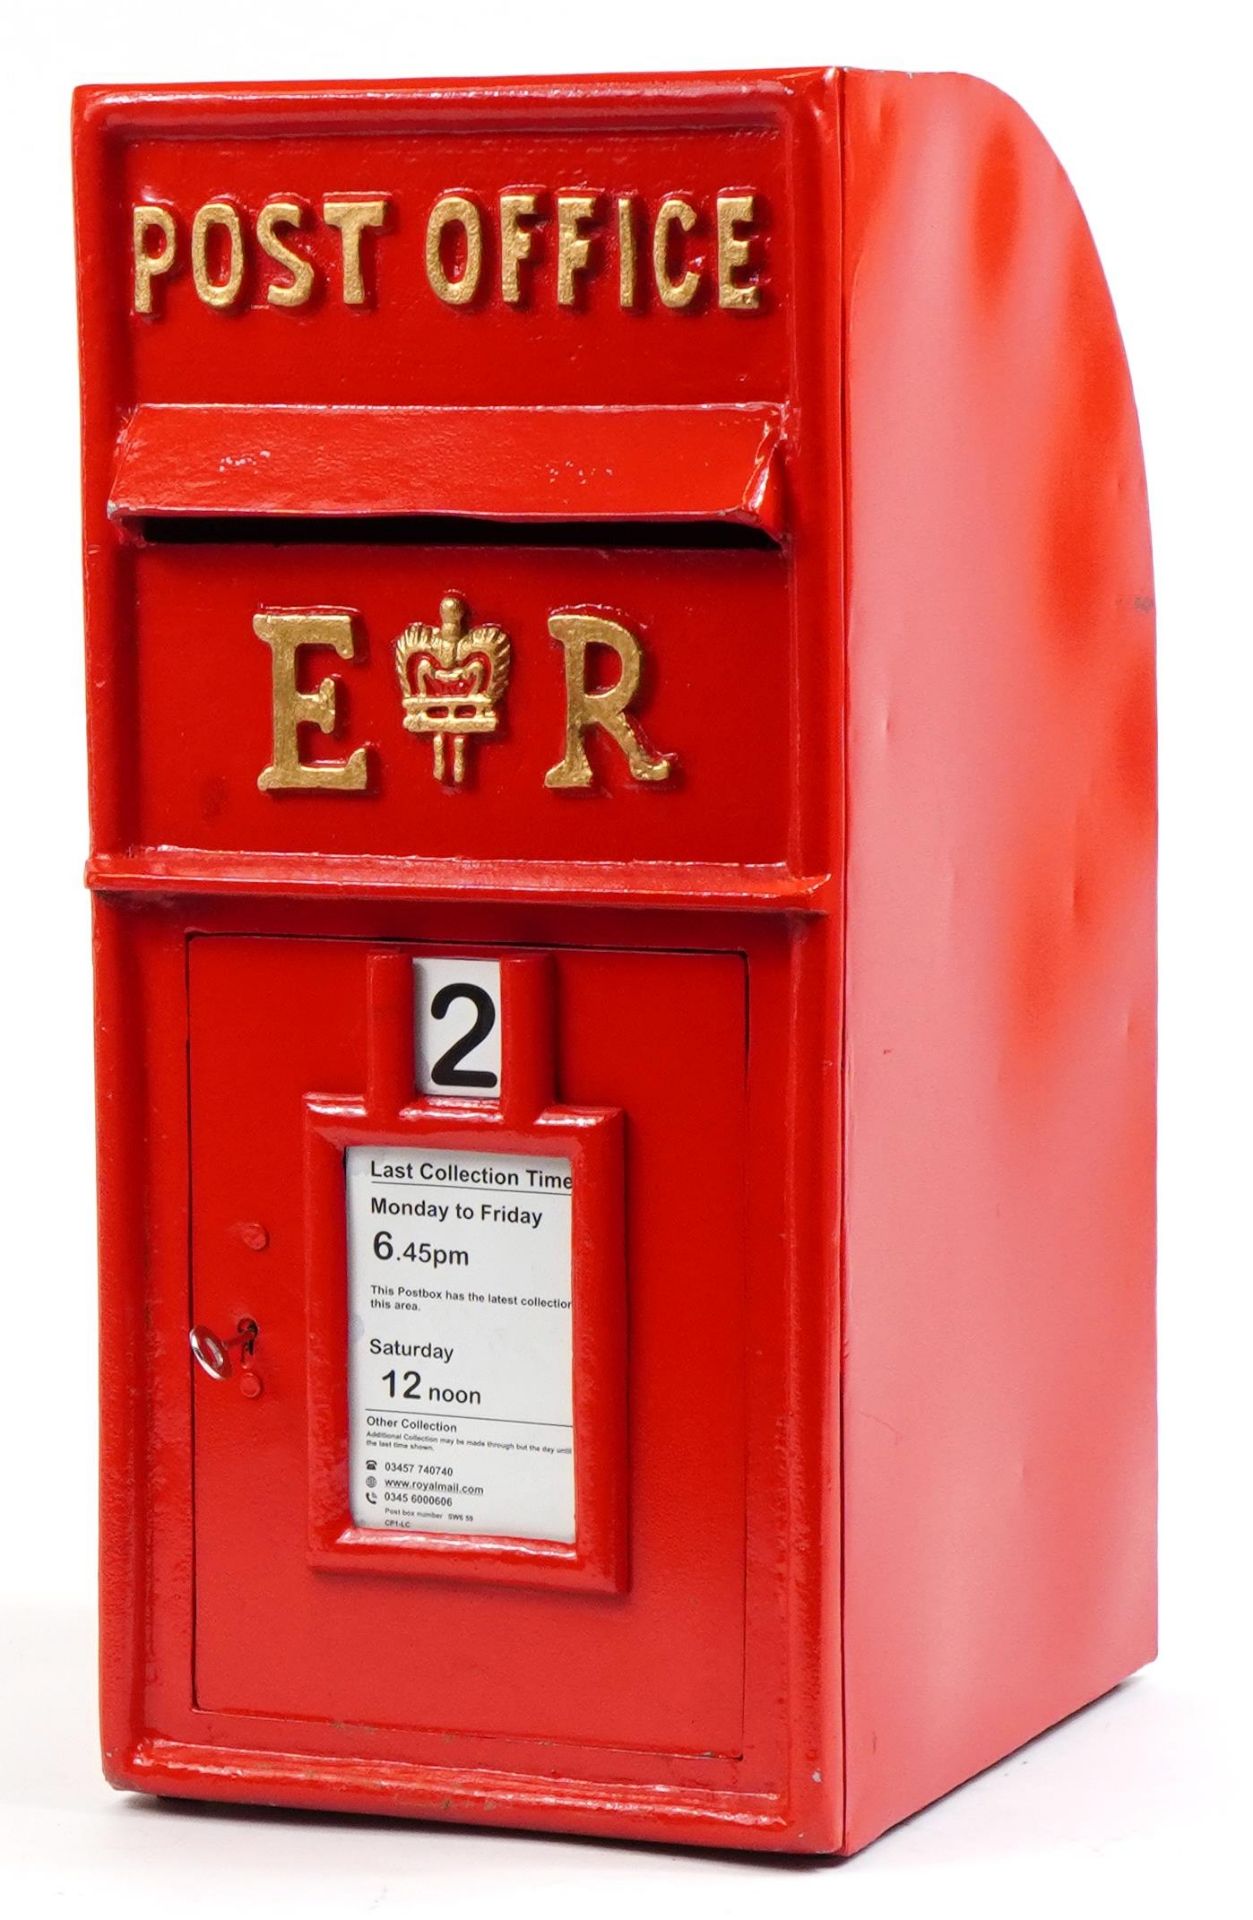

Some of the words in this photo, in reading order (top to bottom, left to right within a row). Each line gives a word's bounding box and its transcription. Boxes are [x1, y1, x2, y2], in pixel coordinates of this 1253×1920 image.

[133, 199, 388, 312] POST
[426, 194, 762, 308] OFFICE
[253, 612, 370, 791] E
[545, 613, 672, 788] R
[430, 983, 498, 1088] 2
[370, 1160, 414, 1179] Last
[419, 1162, 519, 1187] Collection
[525, 1169, 573, 1190] Time
[370, 1197, 450, 1222] Monday
[455, 1203, 475, 1220] to
[480, 1204, 543, 1229] Friday
[372, 1230, 469, 1269] 6.45pm
[370, 1284, 395, 1297] This
[397, 1286, 443, 1300] Postbox
[445, 1289, 465, 1301] has
[467, 1291, 486, 1303] the
[487, 1292, 518, 1305] latest
[370, 1299, 392, 1310] this
[394, 1302, 422, 1311] area.
[369, 1338, 455, 1364] Saturday
[381, 1369, 422, 1400] 12
[428, 1387, 482, 1405] noon
[366, 1415, 398, 1429] Other
[401, 1418, 458, 1433] Collection
[366, 1430, 402, 1440] Additional
[403, 1433, 439, 1444] Collection
[439, 1437, 455, 1447] may
[456, 1438, 465, 1446] be
[516, 1443, 528, 1451] but
[529, 1445, 541, 1453] the
[542, 1447, 555, 1455] day
[366, 1440, 378, 1448] the
[379, 1441, 392, 1450] last
[393, 1442, 409, 1450] time
[384, 1462, 415, 1474] 03457
[417, 1465, 454, 1477] 740740
[384, 1479, 485, 1496] www.royalmail.com
[384, 1492, 409, 1503] 0345
[410, 1494, 453, 1507] 6000606
[384, 1507, 401, 1516] Post
[402, 1509, 416, 1517] box
[416, 1511, 443, 1520] number
